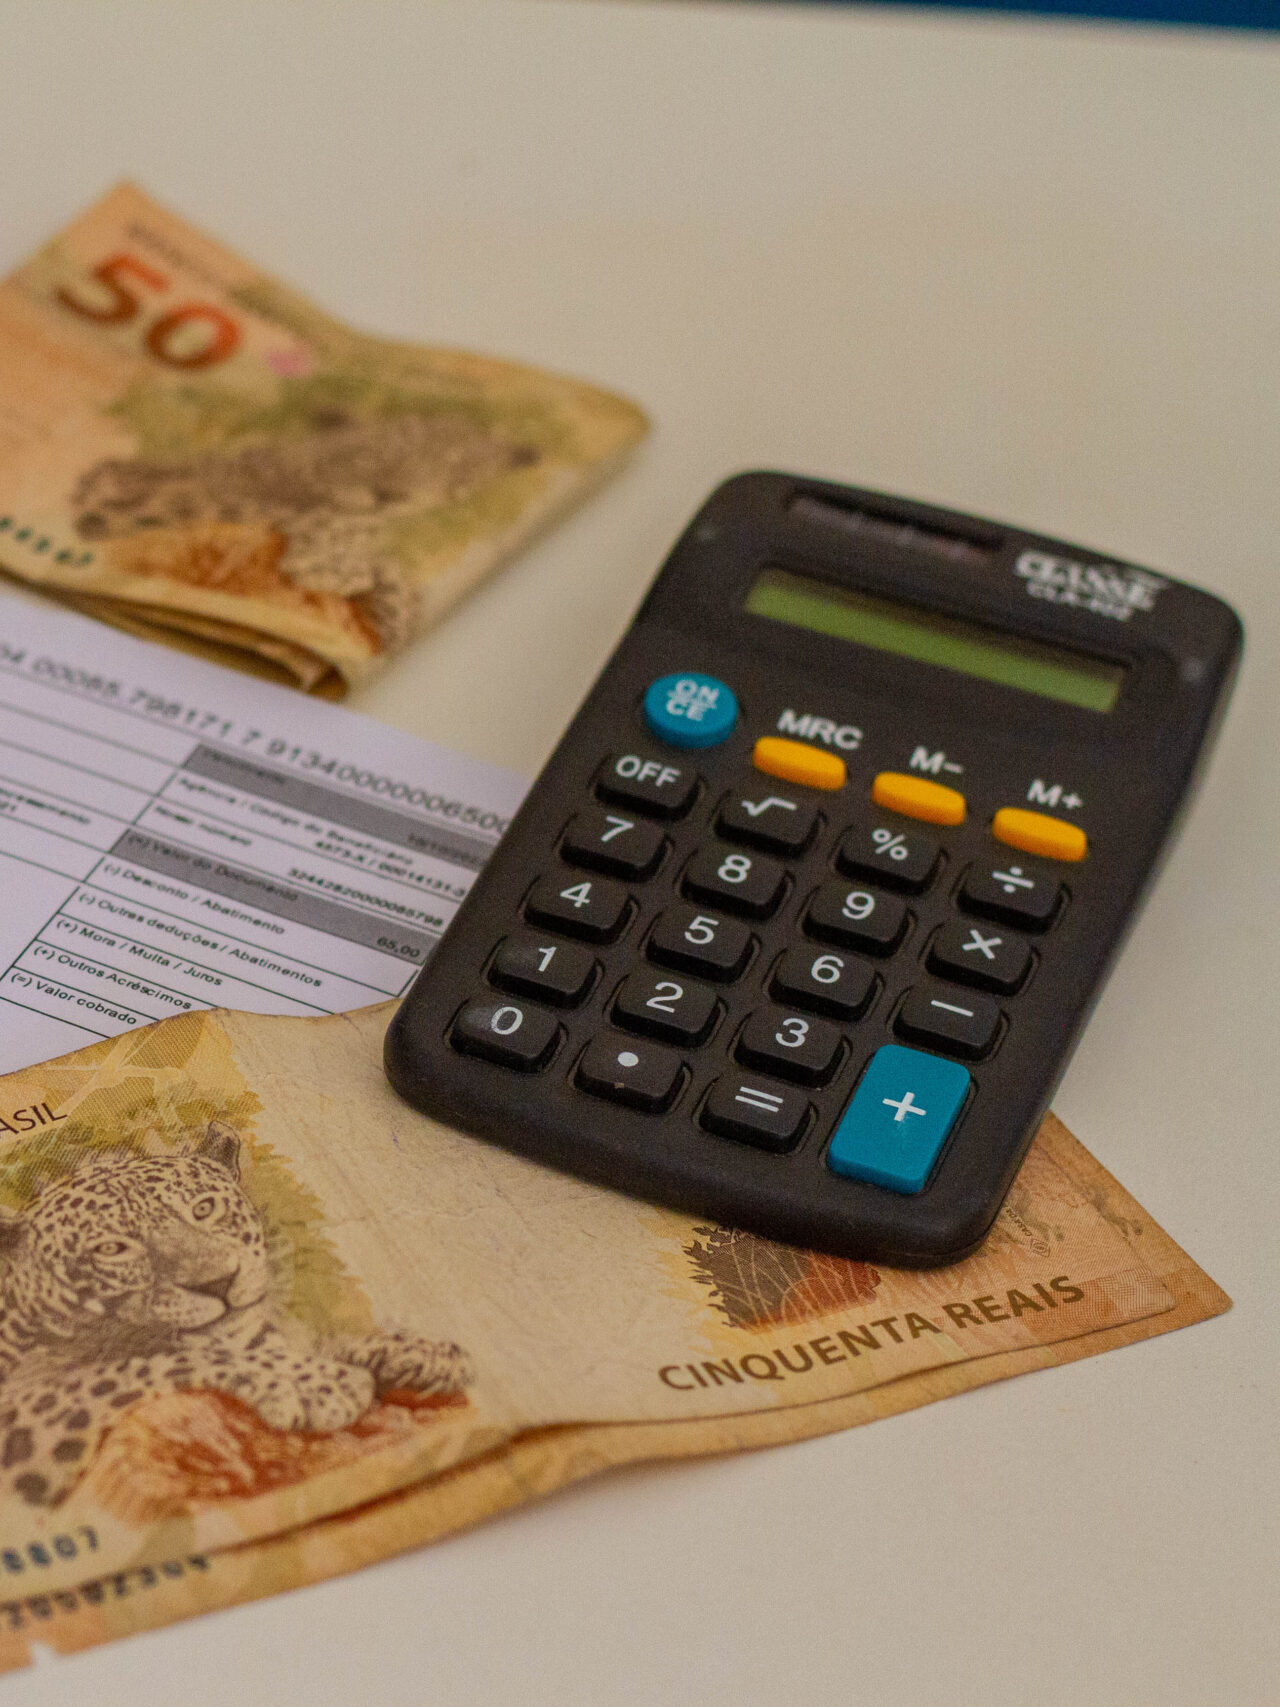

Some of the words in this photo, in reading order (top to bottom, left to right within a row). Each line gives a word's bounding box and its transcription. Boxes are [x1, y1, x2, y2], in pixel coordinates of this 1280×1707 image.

[53, 254, 244, 372] 50
[666, 698, 706, 721] CE
[675, 679, 720, 709] ON
[777, 709, 862, 750] MRC
[615, 755, 681, 788] OFF
[910, 746, 964, 776] M-
[1028, 779, 1084, 811] M+
[601, 816, 634, 842] 7
[872, 828, 908, 861] %
[717, 854, 752, 883] 8
[120, 869, 190, 900] Desconto
[199, 898, 287, 935] Abatimento
[560, 882, 592, 908] 4
[842, 891, 875, 920] 9
[95, 899, 146, 923] Outras
[143, 916, 221, 951] deduções
[227, 947, 324, 987] Abatimentos
[684, 915, 719, 945] 5
[57, 917, 78, 933] (+)
[78, 927, 118, 947] Mora
[127, 945, 172, 966] Multa
[182, 965, 225, 986] Juros
[374, 936, 421, 958] 65,00
[538, 946, 558, 972] 1
[33, 945, 56, 961] (+)
[55, 954, 106, 977] Outros
[104, 970, 195, 1009] Acréscimos
[811, 955, 844, 984] 6
[10, 972, 33, 988] (=)
[33, 981, 76, 1002] Valor
[75, 996, 139, 1024] cobrado
[646, 982, 684, 1013] 2
[490, 1006, 524, 1035] 0
[775, 1017, 809, 1048] 3
[658, 1310, 942, 1392] CINQUENTA
[949, 1275, 1086, 1331] REAIS
